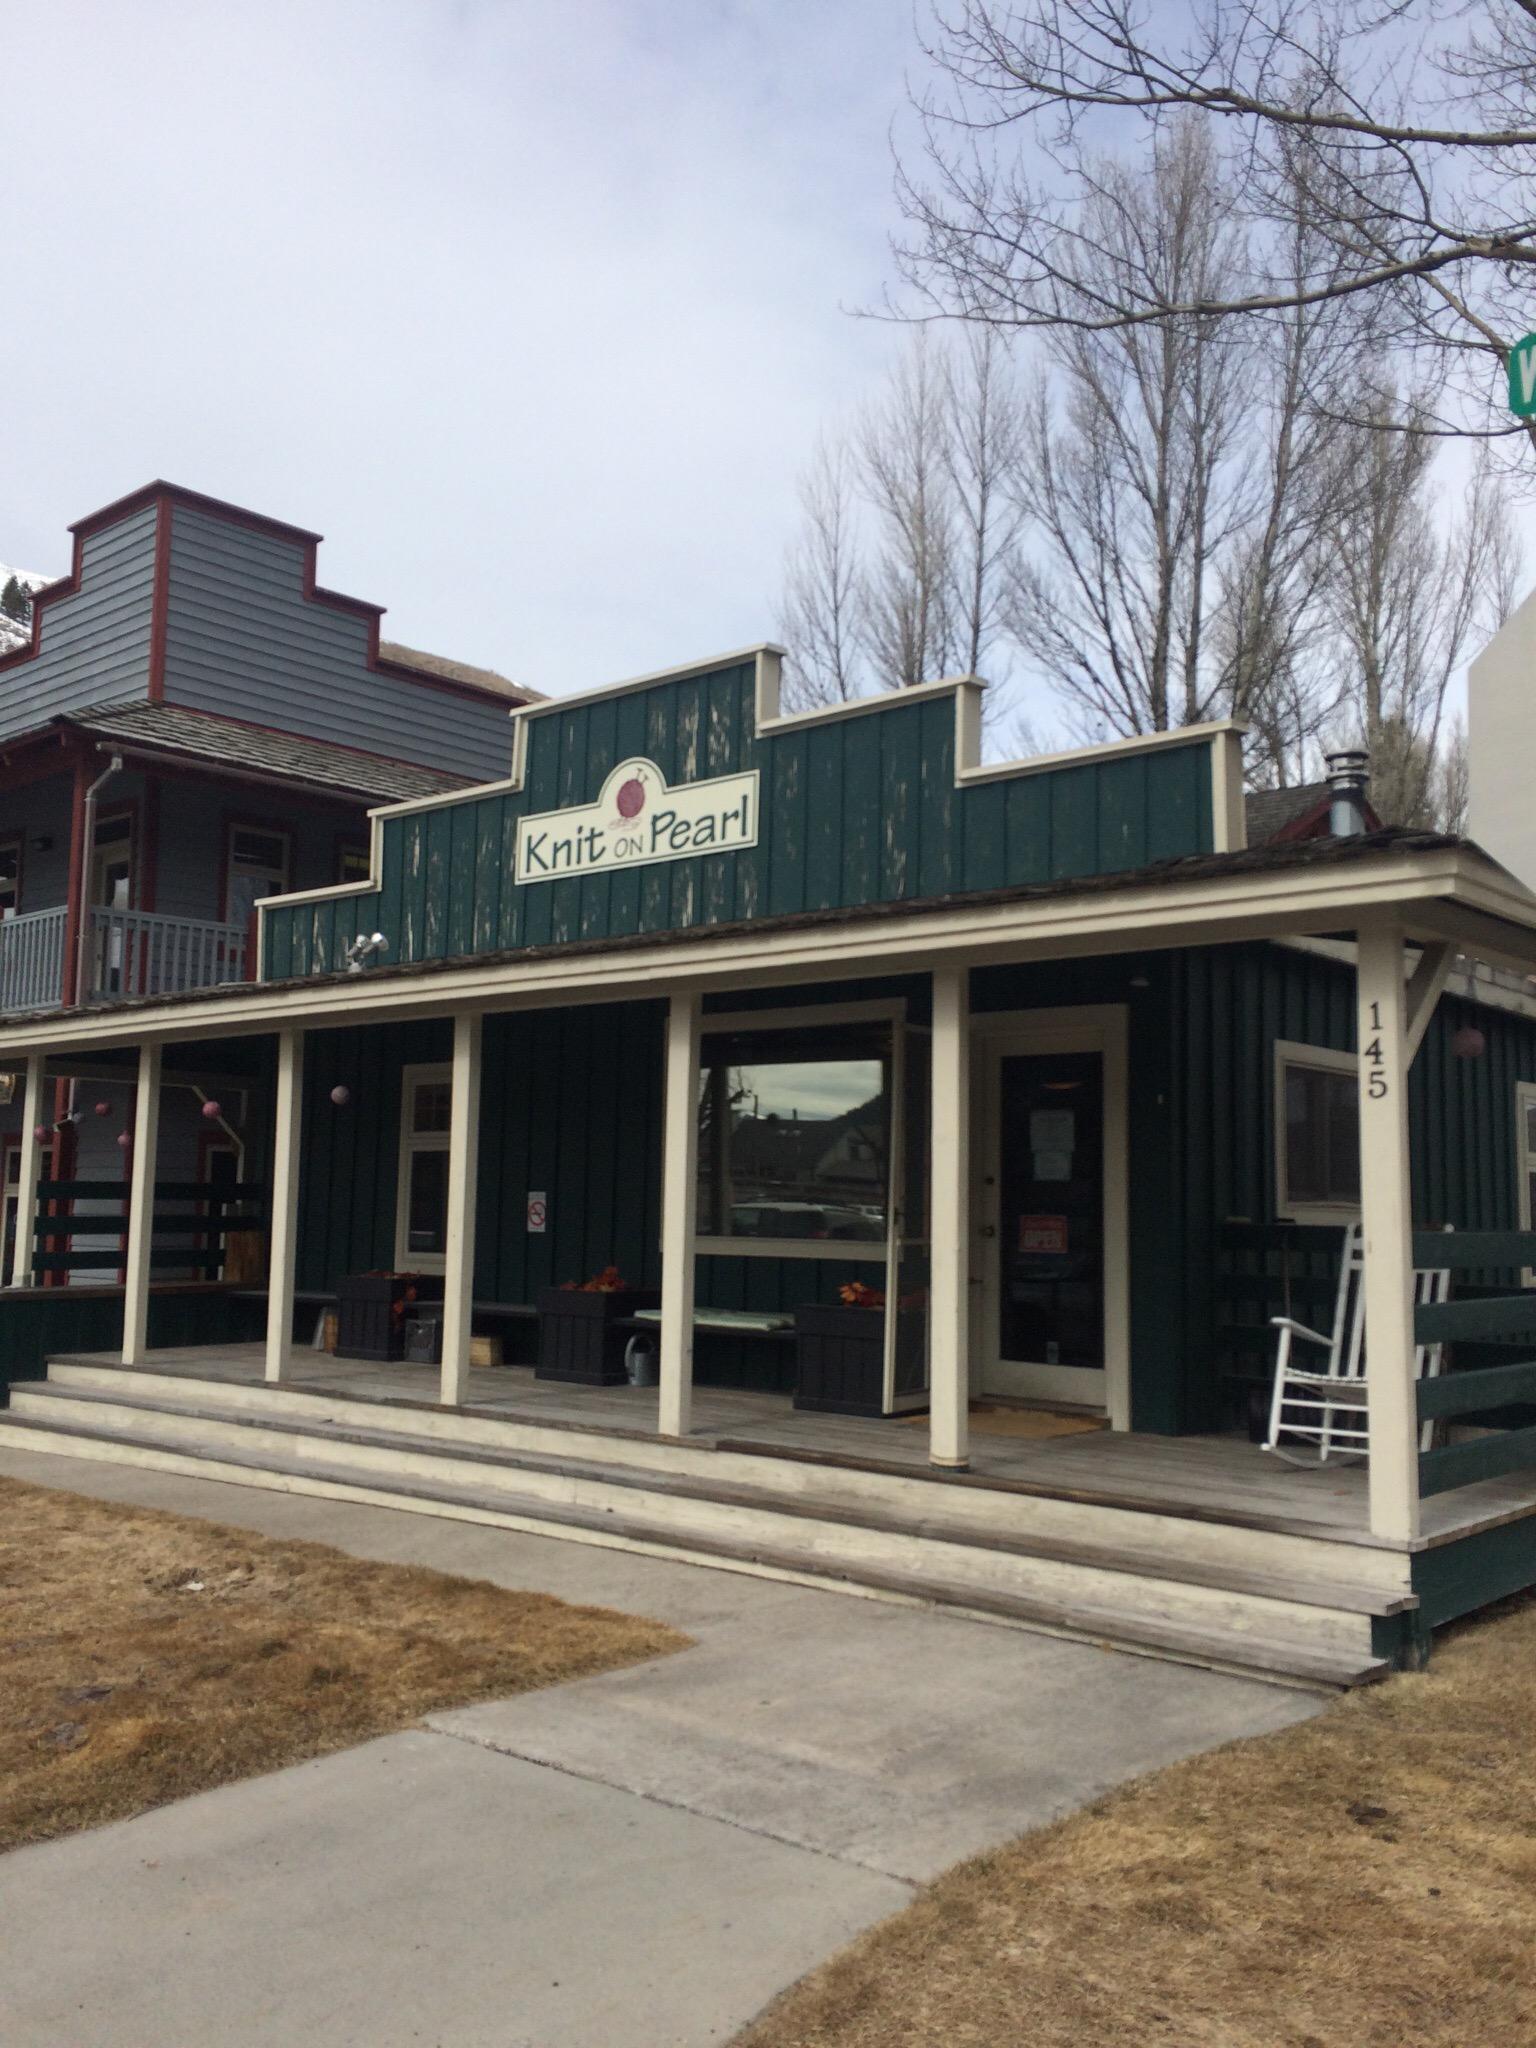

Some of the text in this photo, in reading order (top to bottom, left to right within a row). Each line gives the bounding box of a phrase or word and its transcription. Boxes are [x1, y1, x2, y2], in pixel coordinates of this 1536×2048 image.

[526, 794, 748, 874] Knit ON Pearl
[1365, 1001, 1388, 1099] 145
